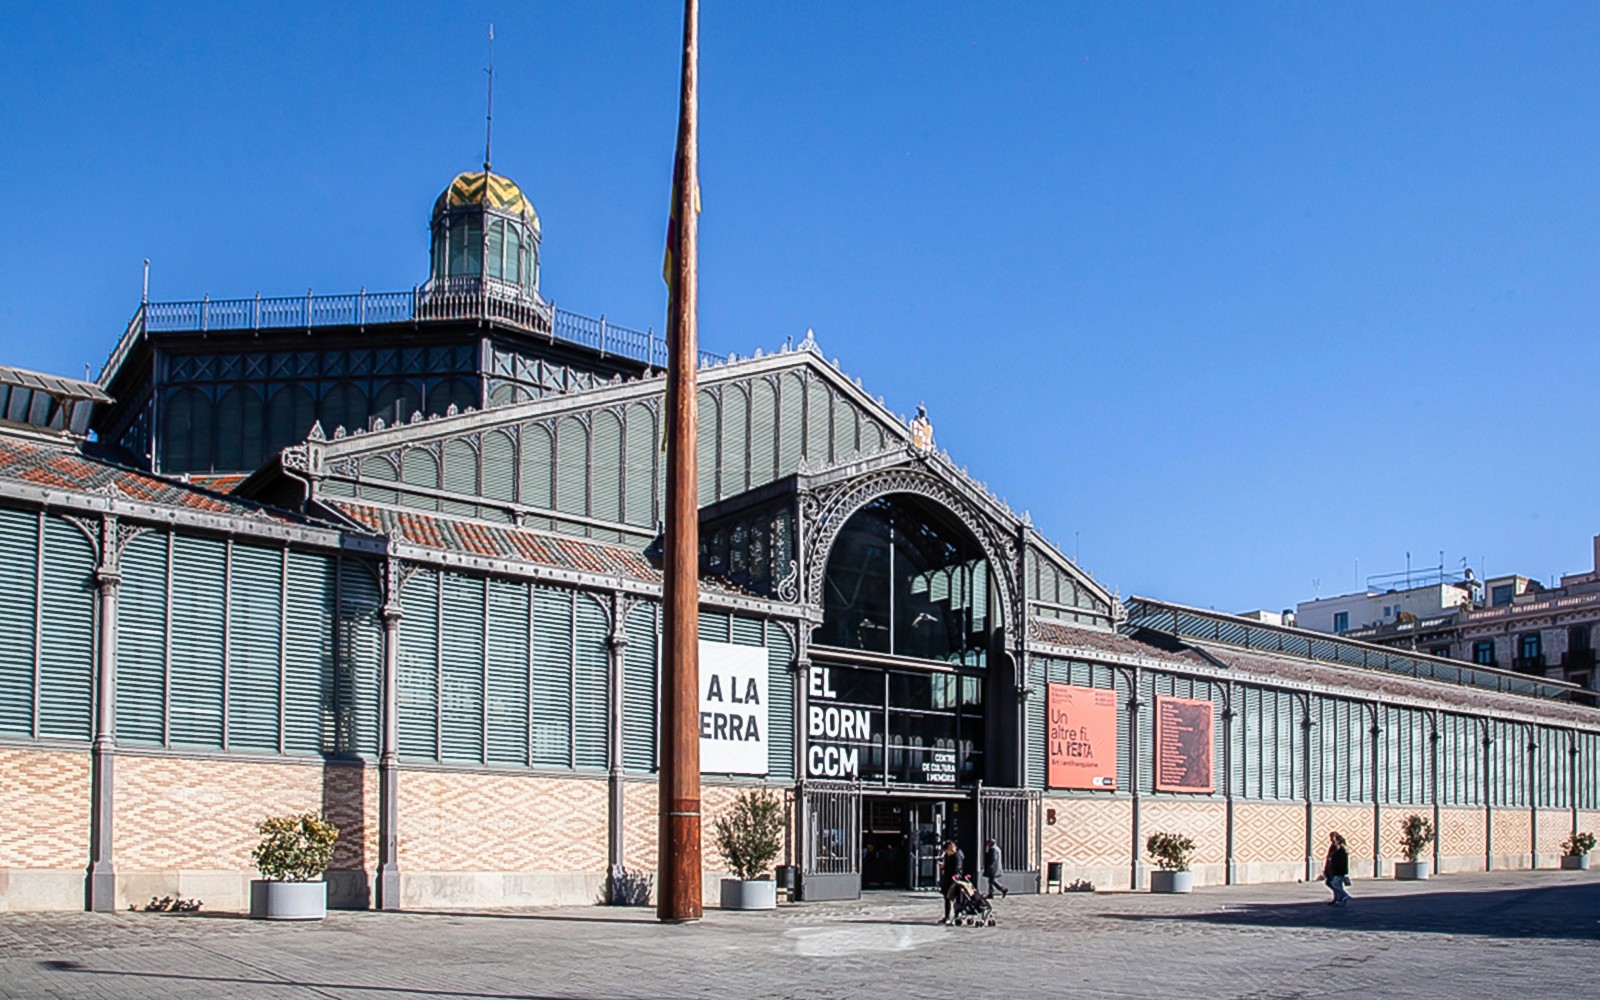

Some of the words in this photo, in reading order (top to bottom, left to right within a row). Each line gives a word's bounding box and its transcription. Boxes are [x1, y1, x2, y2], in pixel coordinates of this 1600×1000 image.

[707, 674, 723, 702] A
[731, 676, 760, 705] LA
[809, 667, 836, 698] EL
[699, 711, 760, 742] ERRA
[809, 706, 870, 740] BORN
[1051, 708, 1068, 724] Un
[1051, 725, 1077, 741] altre
[1051, 741, 1062, 756] LA
[808, 745, 858, 777] CCM
[1046, 808, 1057, 826] B
